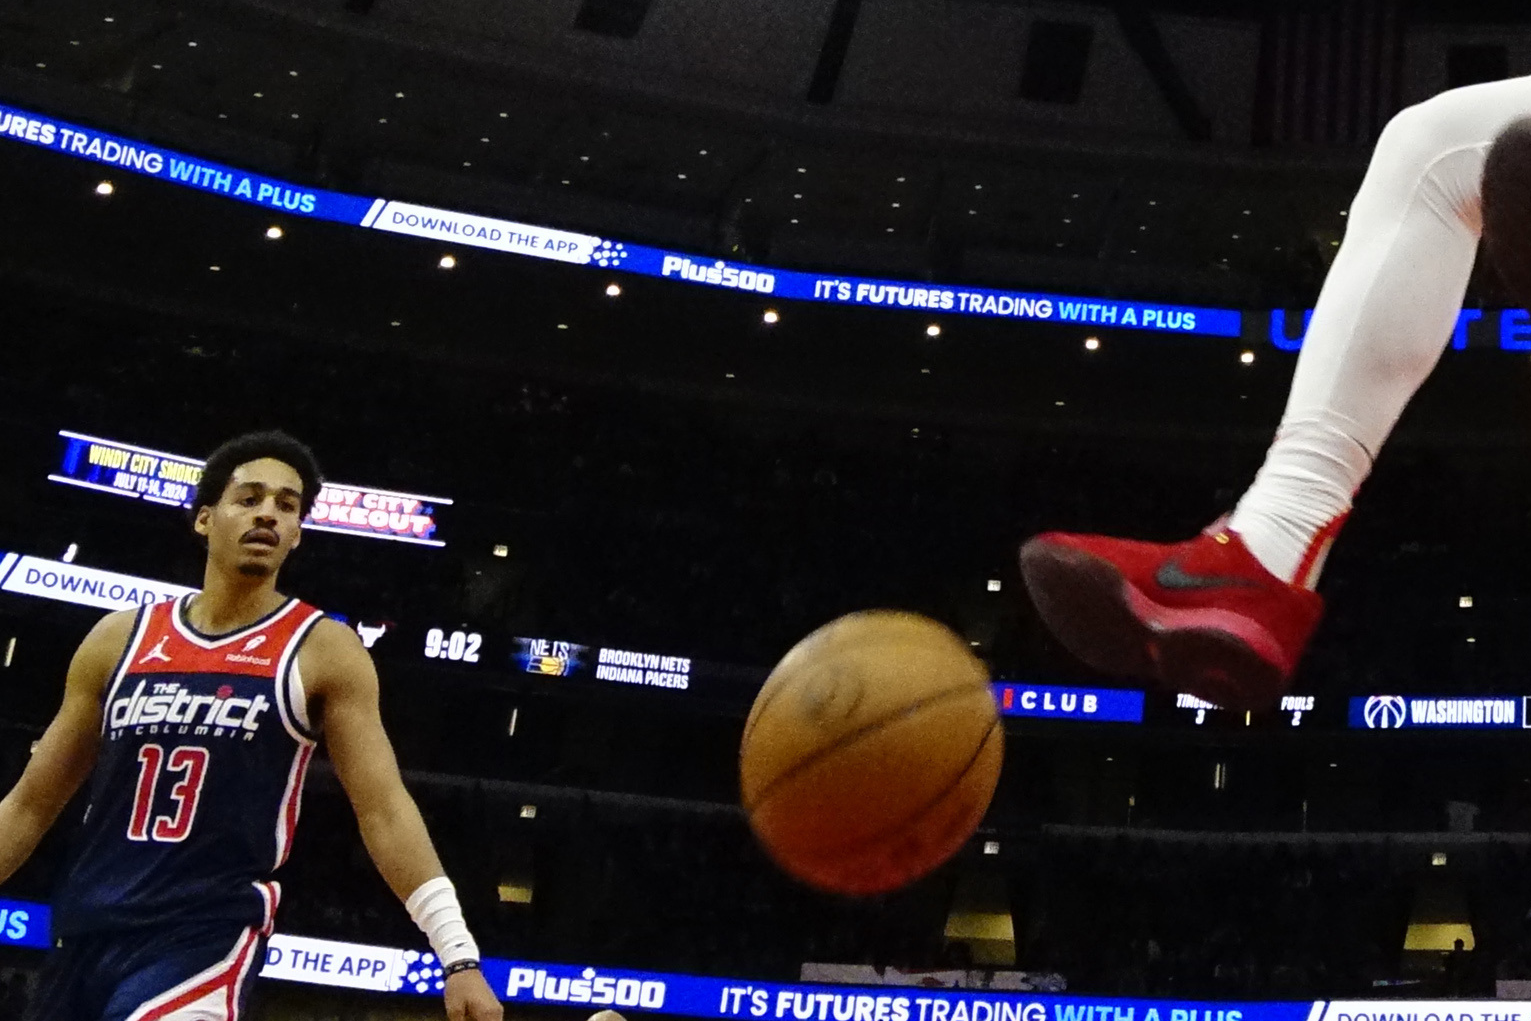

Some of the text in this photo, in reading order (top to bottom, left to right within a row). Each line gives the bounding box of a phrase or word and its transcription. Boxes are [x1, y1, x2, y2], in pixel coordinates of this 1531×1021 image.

[60, 128, 163, 174] TRADING
[168, 158, 232, 194] WITH
[234, 176, 253, 200] A
[256, 184, 317, 214] PLUS
[391, 210, 579, 256] DOWNLOAD THE APP
[661, 253, 775, 295] Plus500
[814, 278, 1196, 331] IT'S FUTURES TRADING WITH A PLUS
[89, 444, 130, 470] WINDY
[130, 454, 159, 476] CITY
[113, 471, 138, 490] JULY
[162, 482, 188, 501] 2024
[362, 493, 418, 514] CITY
[25, 567, 156, 606] DOWNLOAD
[424, 628, 482, 662] 9:02
[598, 647, 691, 674] BROOKLYN NETS
[152, 682, 181, 695] THE
[596, 665, 690, 690] INDIANA PACERS
[109, 678, 271, 732] district
[1020, 690, 1098, 713] CLUB
[1280, 695, 1315, 711] FOULS
[1411, 700, 1515, 724] WASHINGTON
[134, 725, 256, 742] COLUMBIA
[126, 743, 209, 844] 13
[291, 948, 334, 973] THE
[337, 955, 387, 979] APP
[508, 967, 666, 1010] Plus500
[720, 985, 769, 1017] IT'S
[774, 988, 910, 1021] FUTURES
[915, 997, 1046, 1021] TRADING
[1054, 1003, 1136, 1021] WITH
